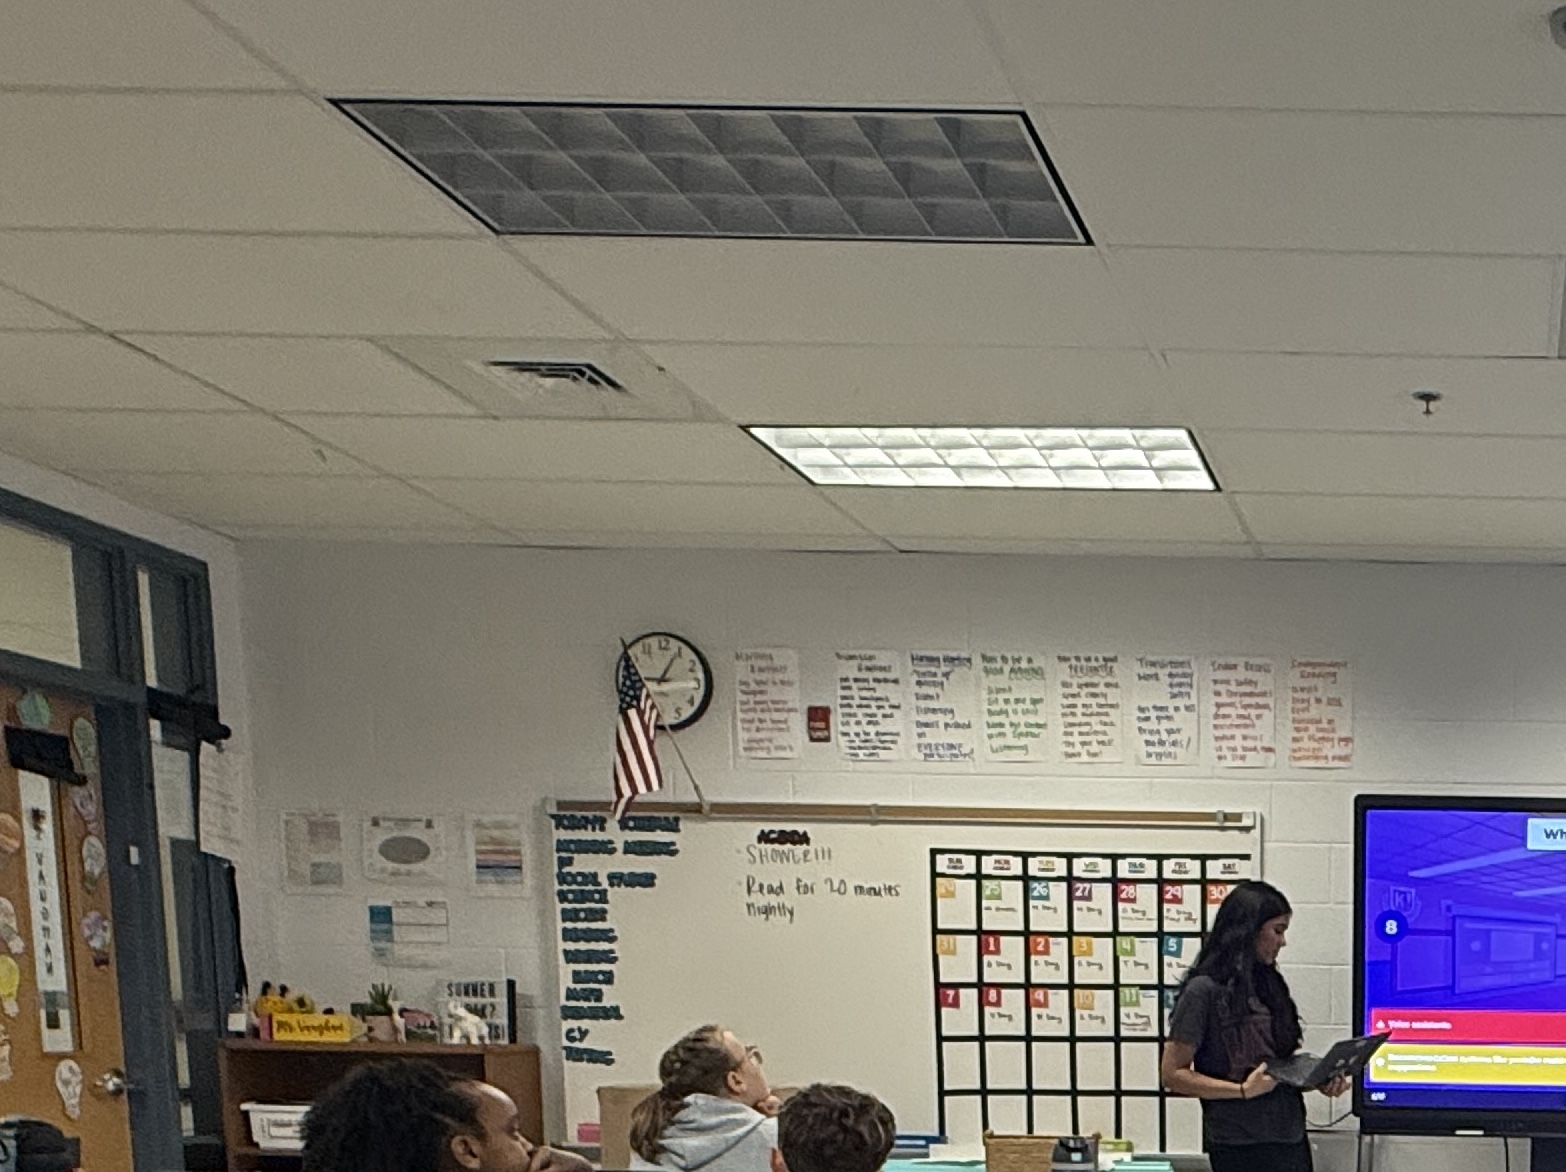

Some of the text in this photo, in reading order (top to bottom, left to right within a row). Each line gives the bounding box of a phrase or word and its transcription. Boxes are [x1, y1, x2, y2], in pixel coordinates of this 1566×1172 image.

[658, 637, 671, 651] 12
[687, 659, 697, 673] 2
[746, 874, 901, 897] Read for 20 minutes
[1031, 884, 1049, 897] 26
[1075, 884, 1092, 897] 27
[1119, 886, 1136, 899] 28
[1164, 886, 1182, 899] 29
[1209, 887, 1226, 899] 30
[1385, 919, 1398, 935] 8
[987, 937, 996, 951] 1
[1035, 937, 1046, 951] 2
[1079, 939, 1088, 951] 3
[1121, 938, 1132, 952] 4
[1167, 938, 1178, 951] 5
[945, 990, 955, 1004] 7
[988, 989, 998, 1003] 8
[1034, 989, 1045, 1004] 9
[1123, 989, 1138, 1004] 11
